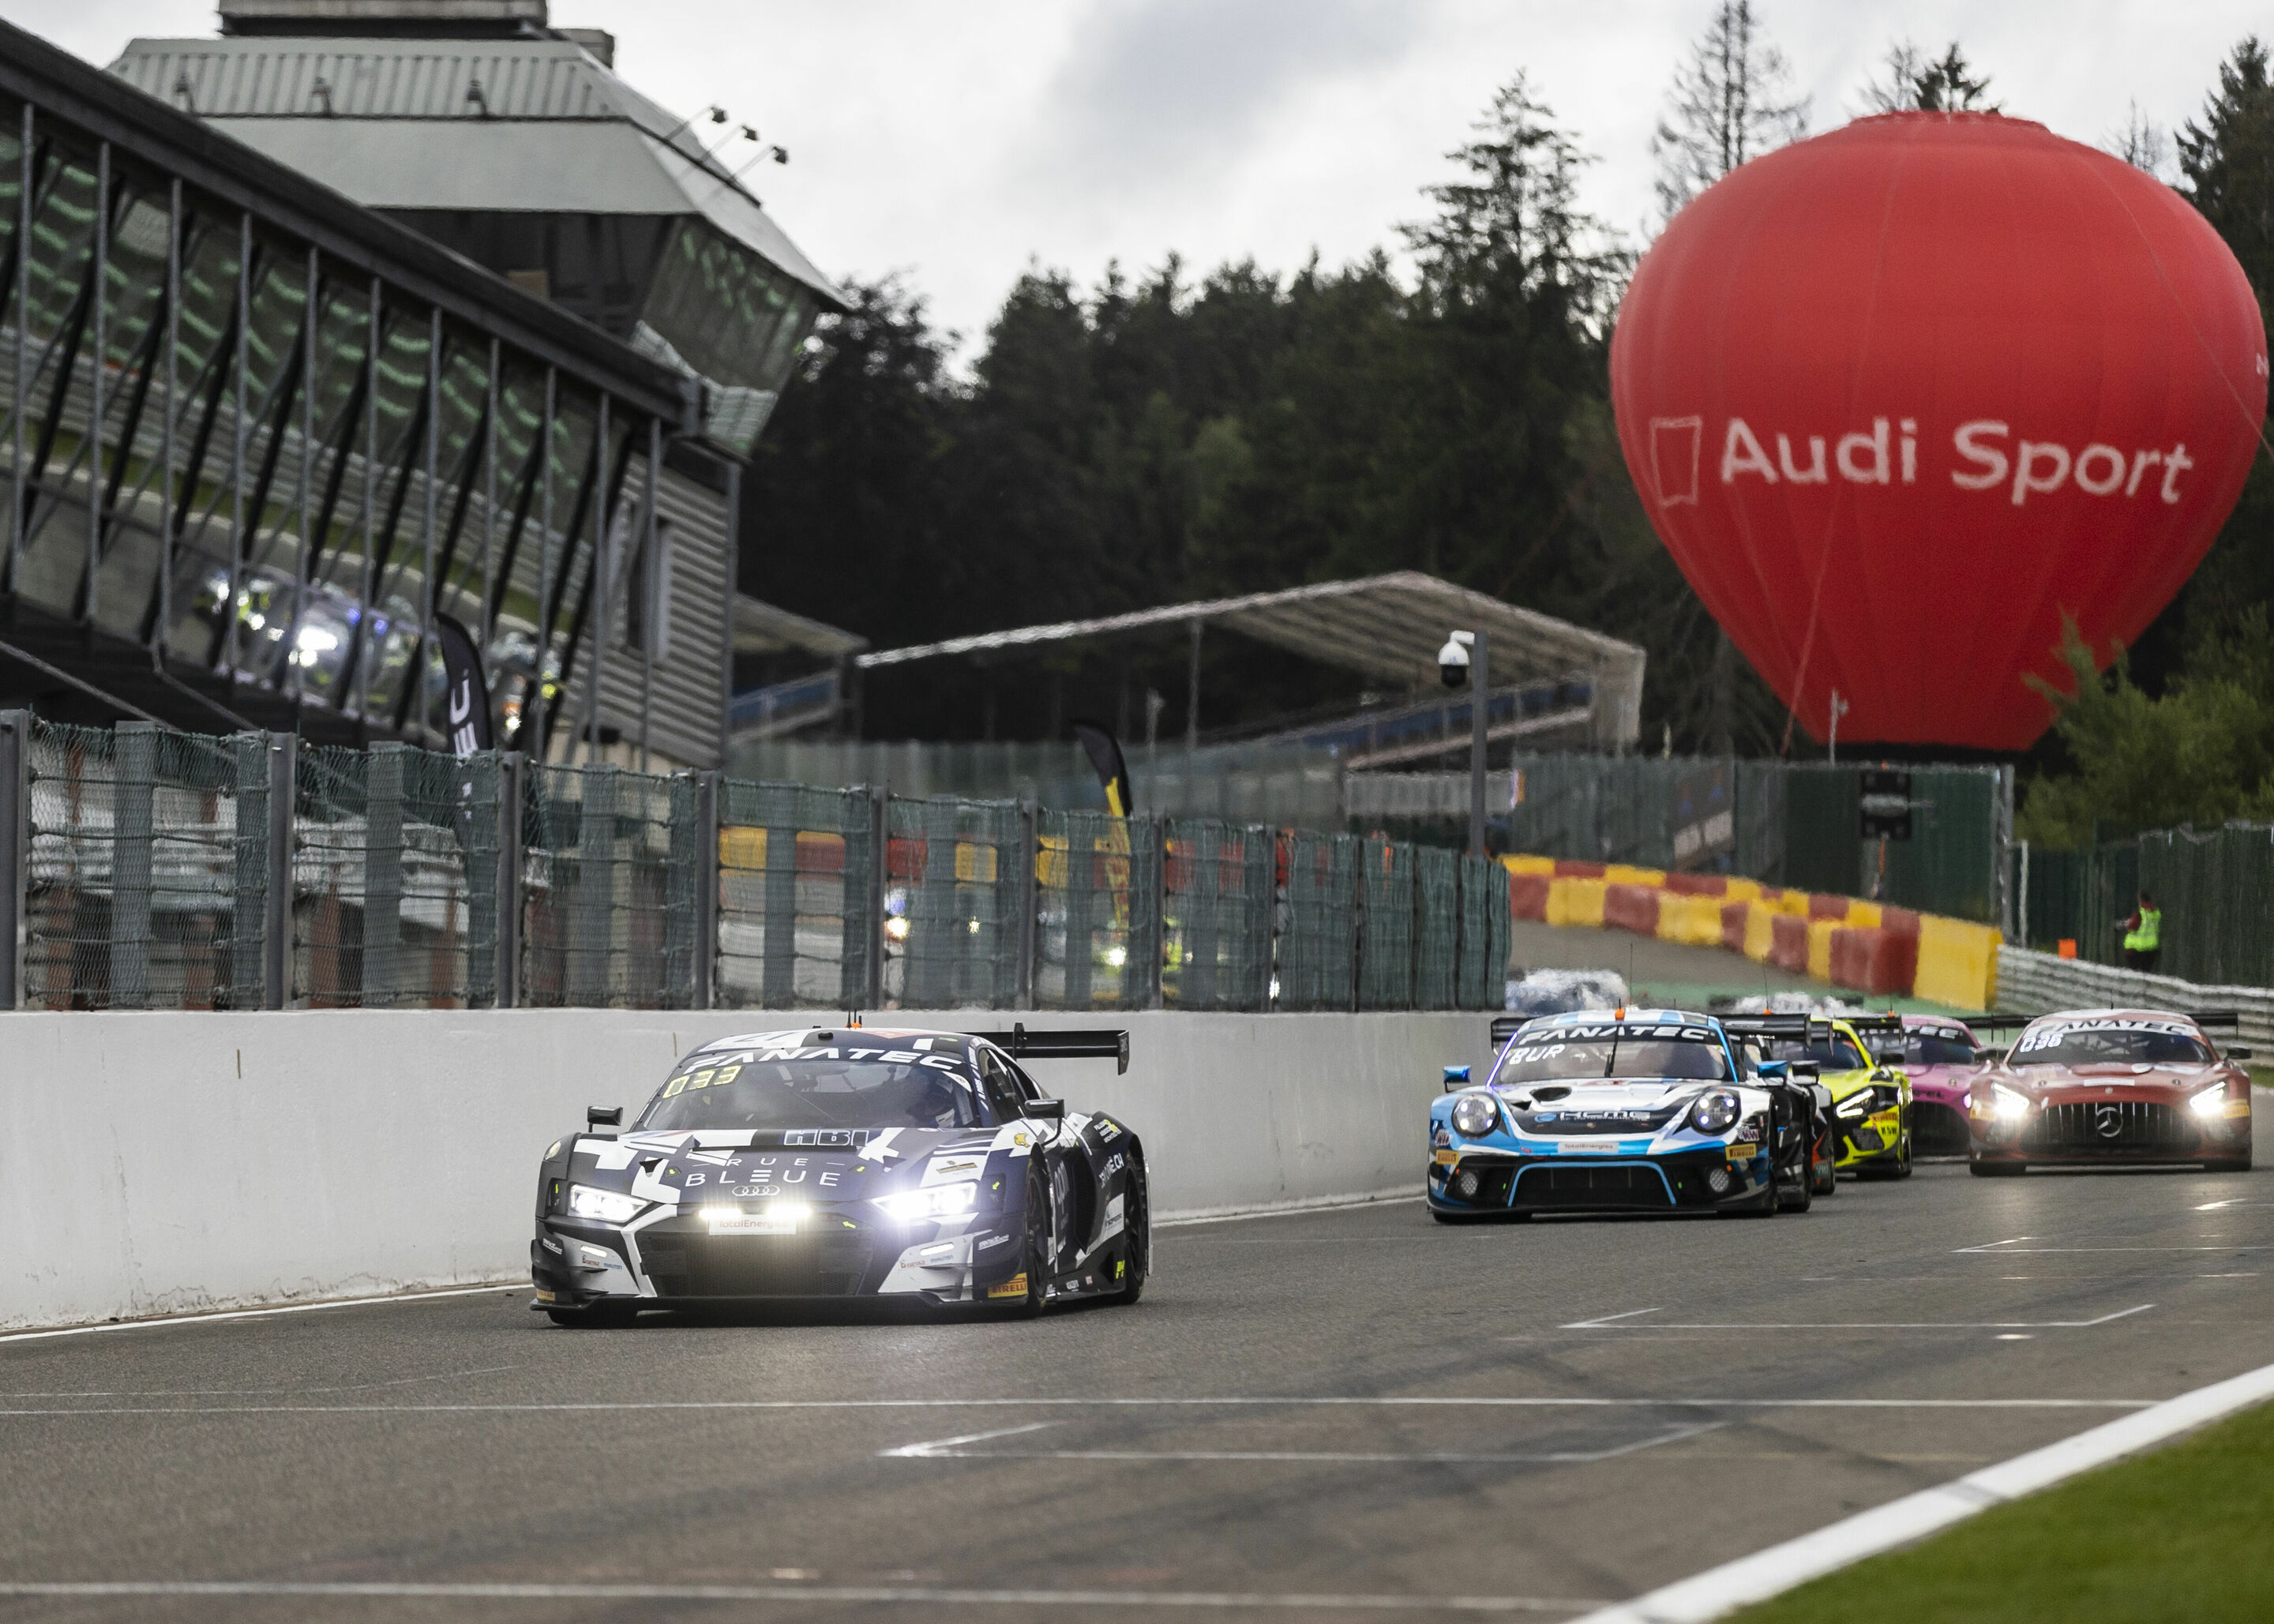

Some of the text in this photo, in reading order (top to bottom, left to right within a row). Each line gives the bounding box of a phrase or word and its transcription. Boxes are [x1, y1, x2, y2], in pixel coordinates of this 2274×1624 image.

[1720, 414, 2193, 507] Audi Sport
[1518, 1026, 1709, 1046] FANATEC
[683, 1048, 963, 1075] FANATEC
[1508, 1044, 1566, 1066] BUR
[662, 1065, 745, 1099] 033
[726, 1157, 809, 1167] RUE
[685, 1169, 841, 1187] BLEUE
[719, 1220, 790, 1229] TotalEnerg
